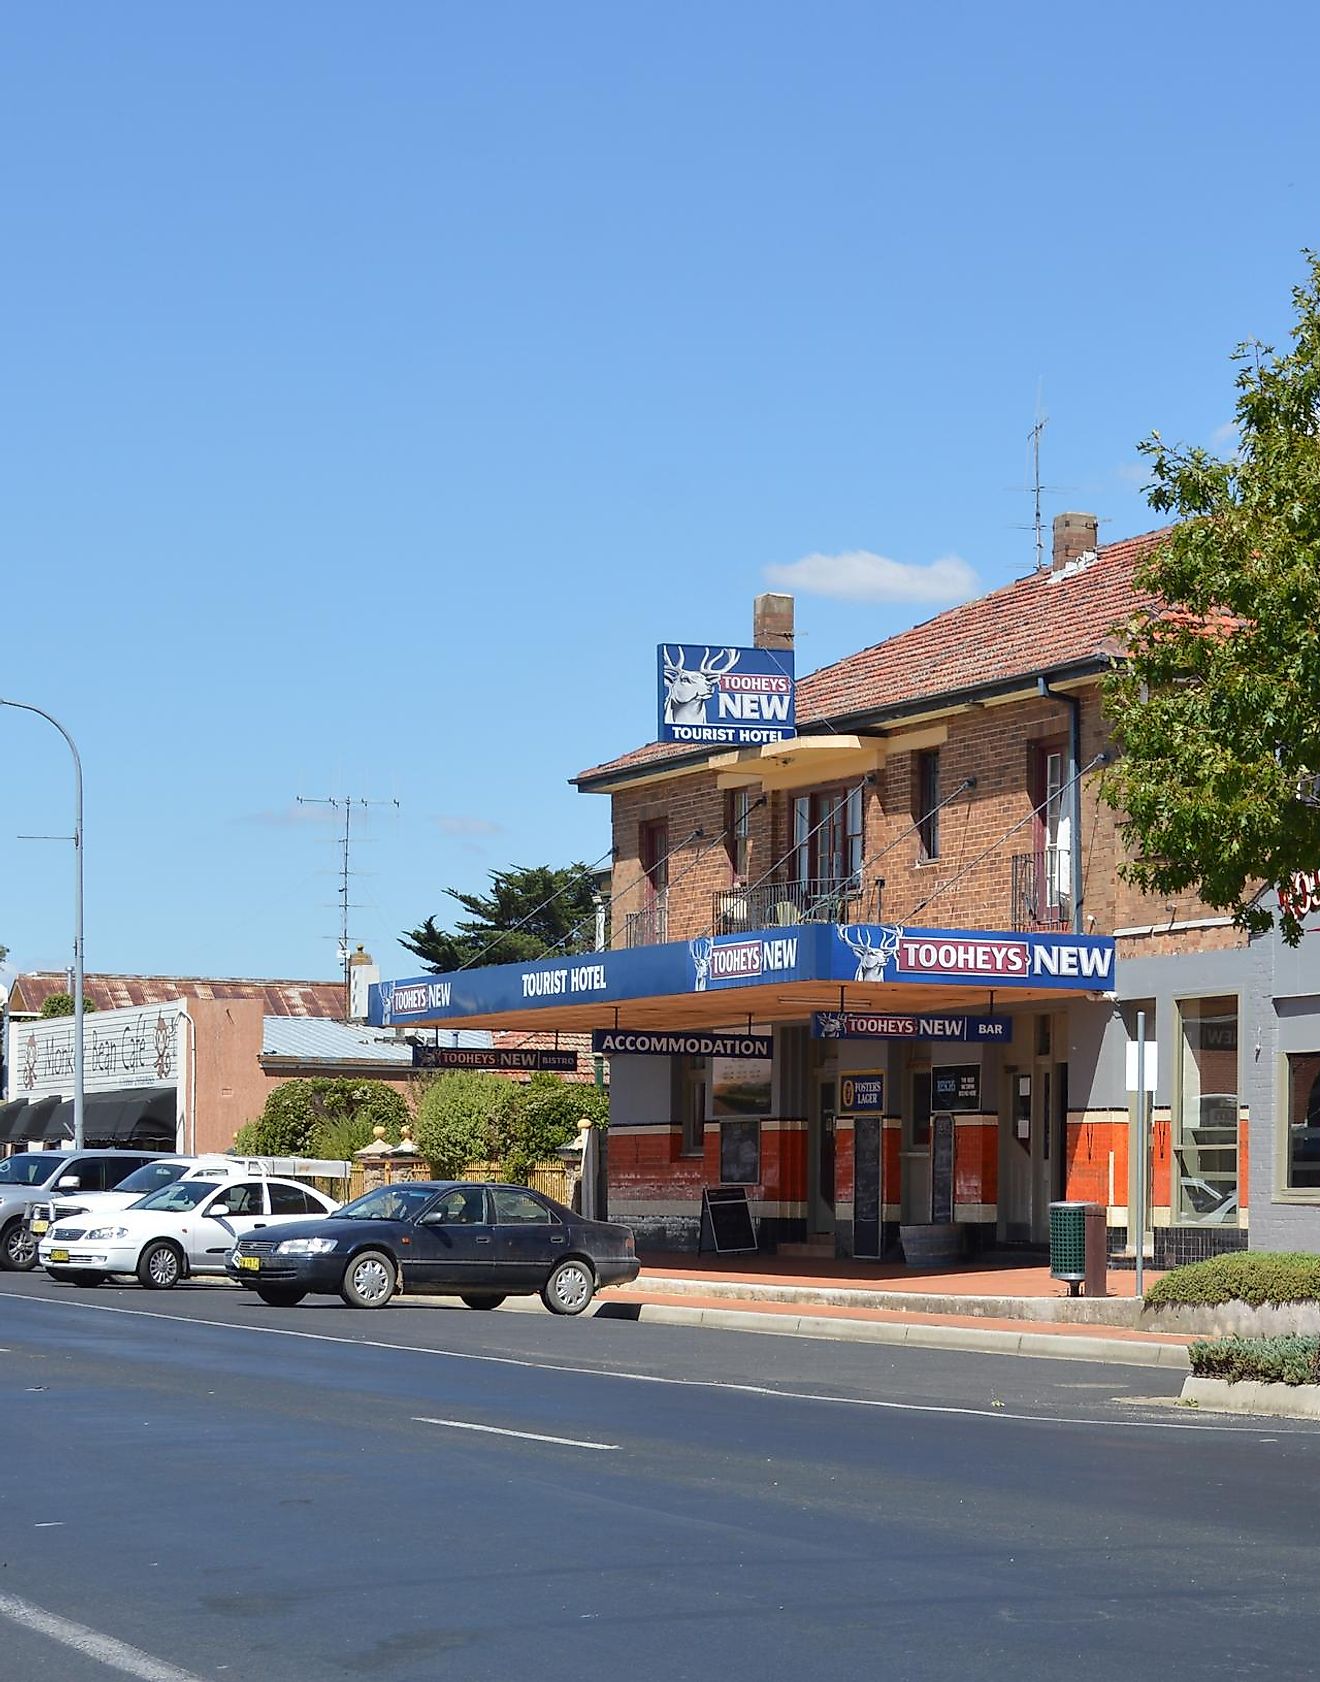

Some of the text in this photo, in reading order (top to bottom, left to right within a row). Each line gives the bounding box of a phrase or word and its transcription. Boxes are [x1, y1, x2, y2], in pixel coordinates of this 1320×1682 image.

[722, 676, 787, 692] TOOHEYS
[718, 693, 791, 721] NEW
[672, 726, 735, 742] TOURIST
[712, 937, 798, 974] TOOHEYS NEW
[903, 942, 1115, 978] TOOHEYS NEW
[521, 964, 607, 998] TOURIST HOTEL
[394, 982, 452, 1011] TOOHEYS NEW
[850, 1016, 1003, 1036] TOOHEYS NEW BAR
[92, 1030, 117, 1076] Bean
[602, 1034, 768, 1056] ACCOMMODATION
[442, 1051, 575, 1067] TOOHEYS NEW BISTRO
[857, 1093, 878, 1104] LAGER
